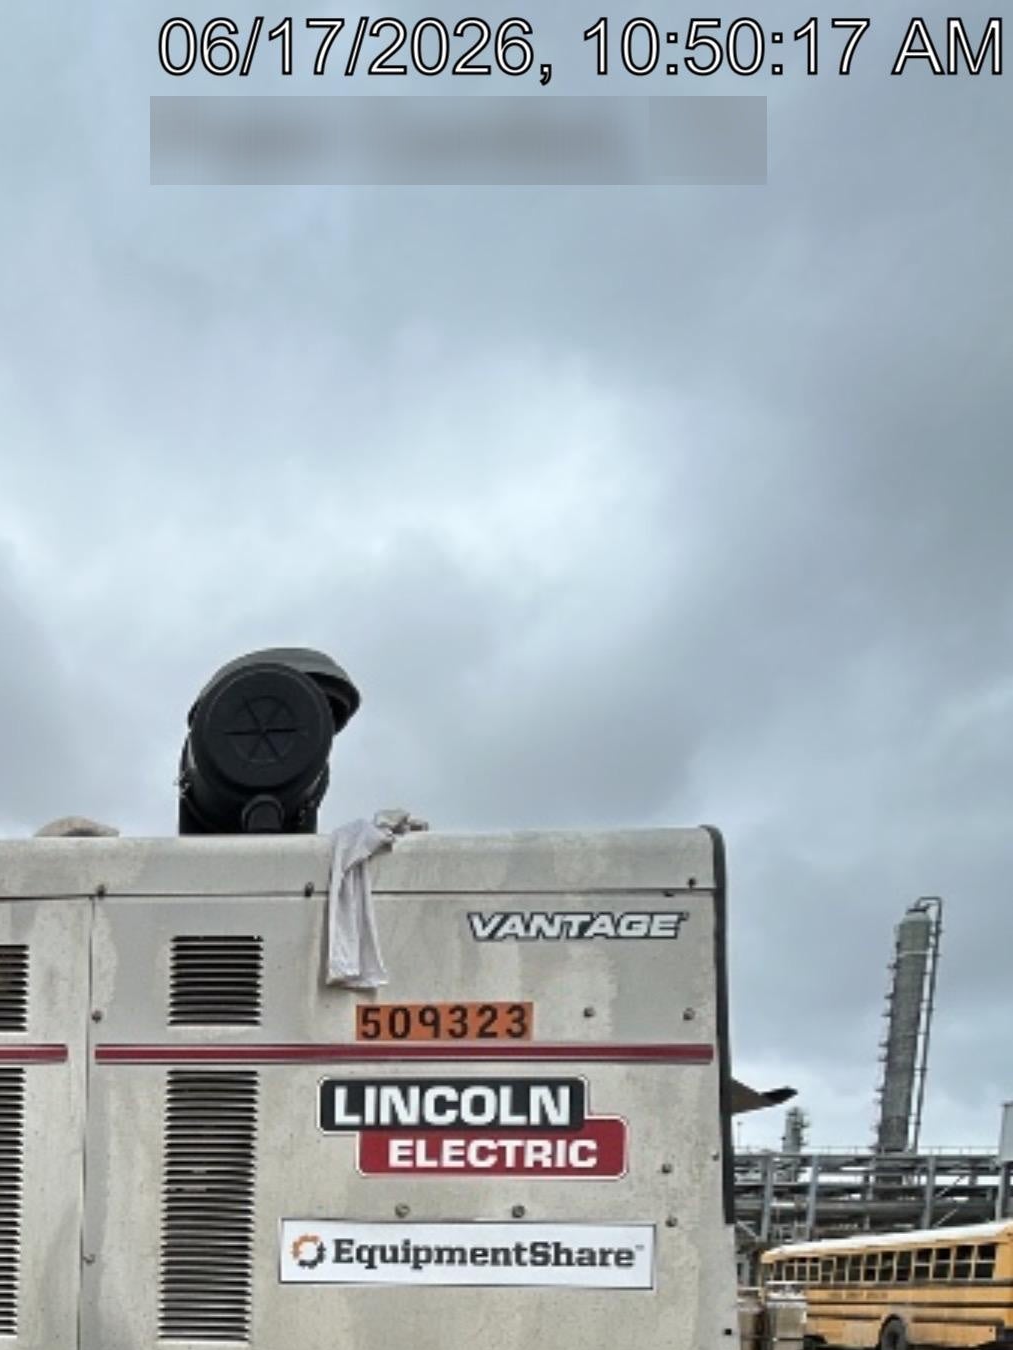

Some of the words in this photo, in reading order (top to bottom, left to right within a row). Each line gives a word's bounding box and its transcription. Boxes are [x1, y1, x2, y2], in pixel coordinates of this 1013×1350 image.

[468, 912, 686, 941] VANTAGE
[360, 1005, 529, 1040] 509323
[333, 1086, 571, 1126] LINCOLN
[388, 1139, 598, 1169] ELECTRIC
[332, 1238, 636, 1271] EquipmentShare
